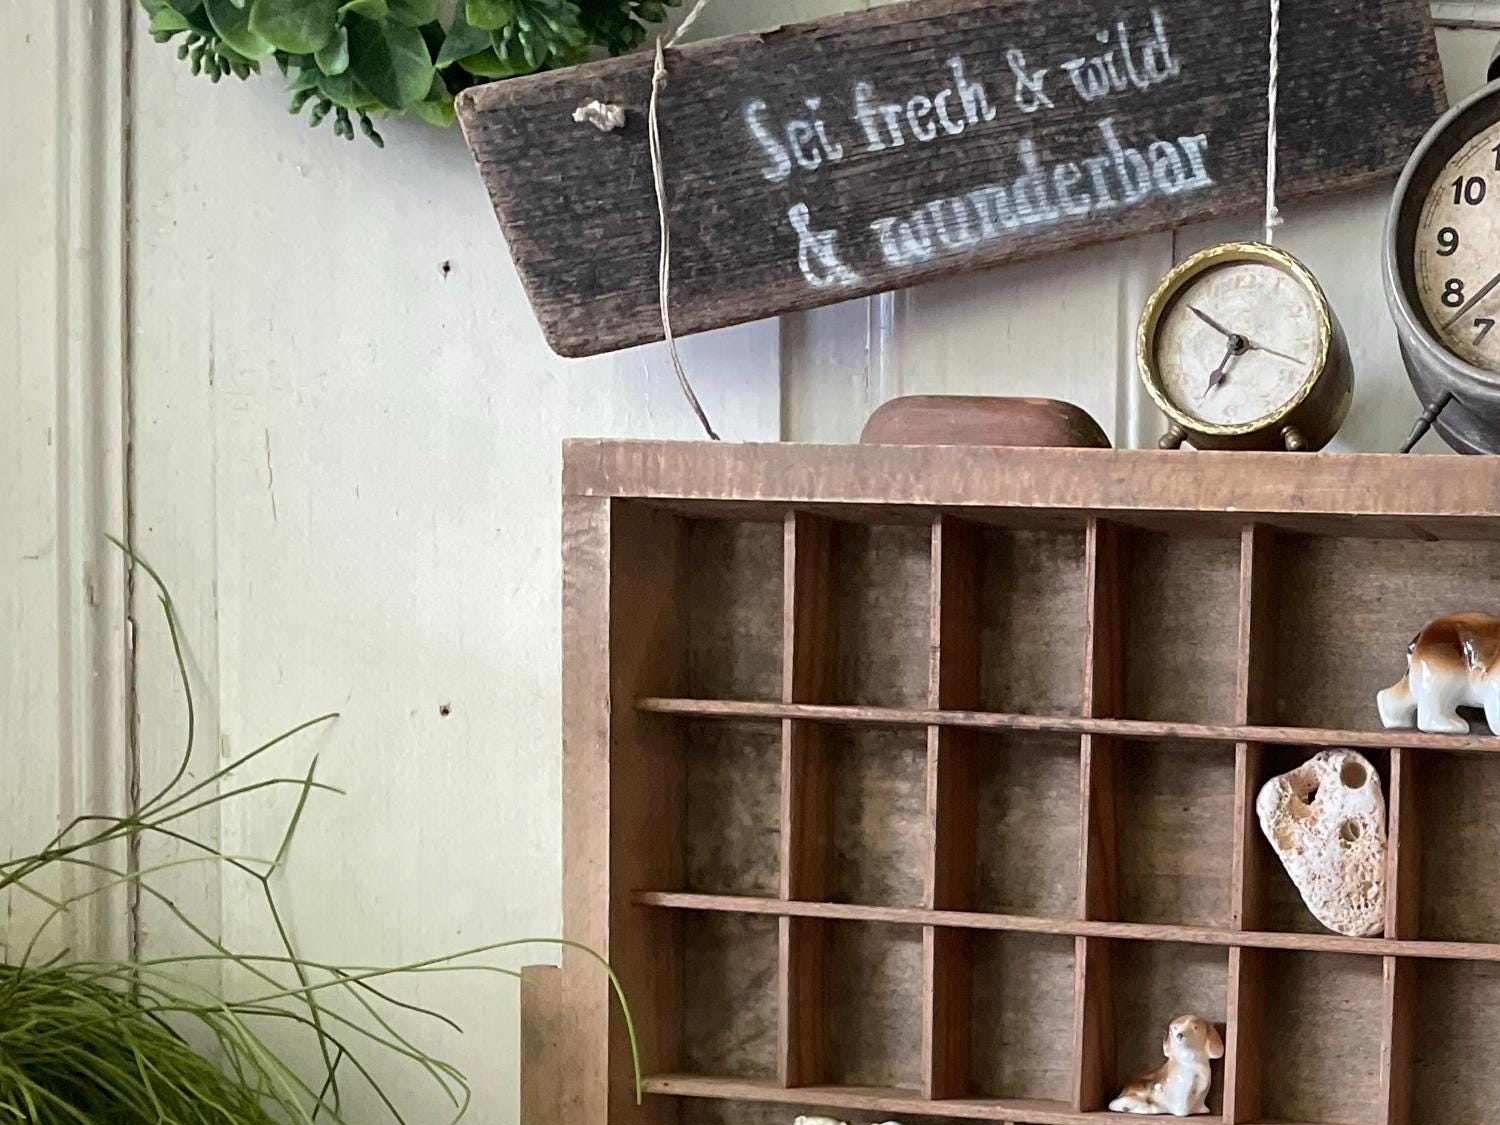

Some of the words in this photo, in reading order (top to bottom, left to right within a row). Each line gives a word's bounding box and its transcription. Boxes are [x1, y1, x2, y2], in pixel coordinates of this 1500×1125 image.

[744, 96, 844, 184] Sei
[850, 52, 998, 152] frech
[1006, 47, 1055, 114] &
[1060, 8, 1182, 102] wild
[786, 200, 862, 288] &
[869, 115, 1216, 267] wunderbar
[1451, 176, 1487, 206] 10
[1436, 227, 1460, 256] 9
[1441, 278, 1465, 308] 8
[1472, 318, 1495, 346] 7
